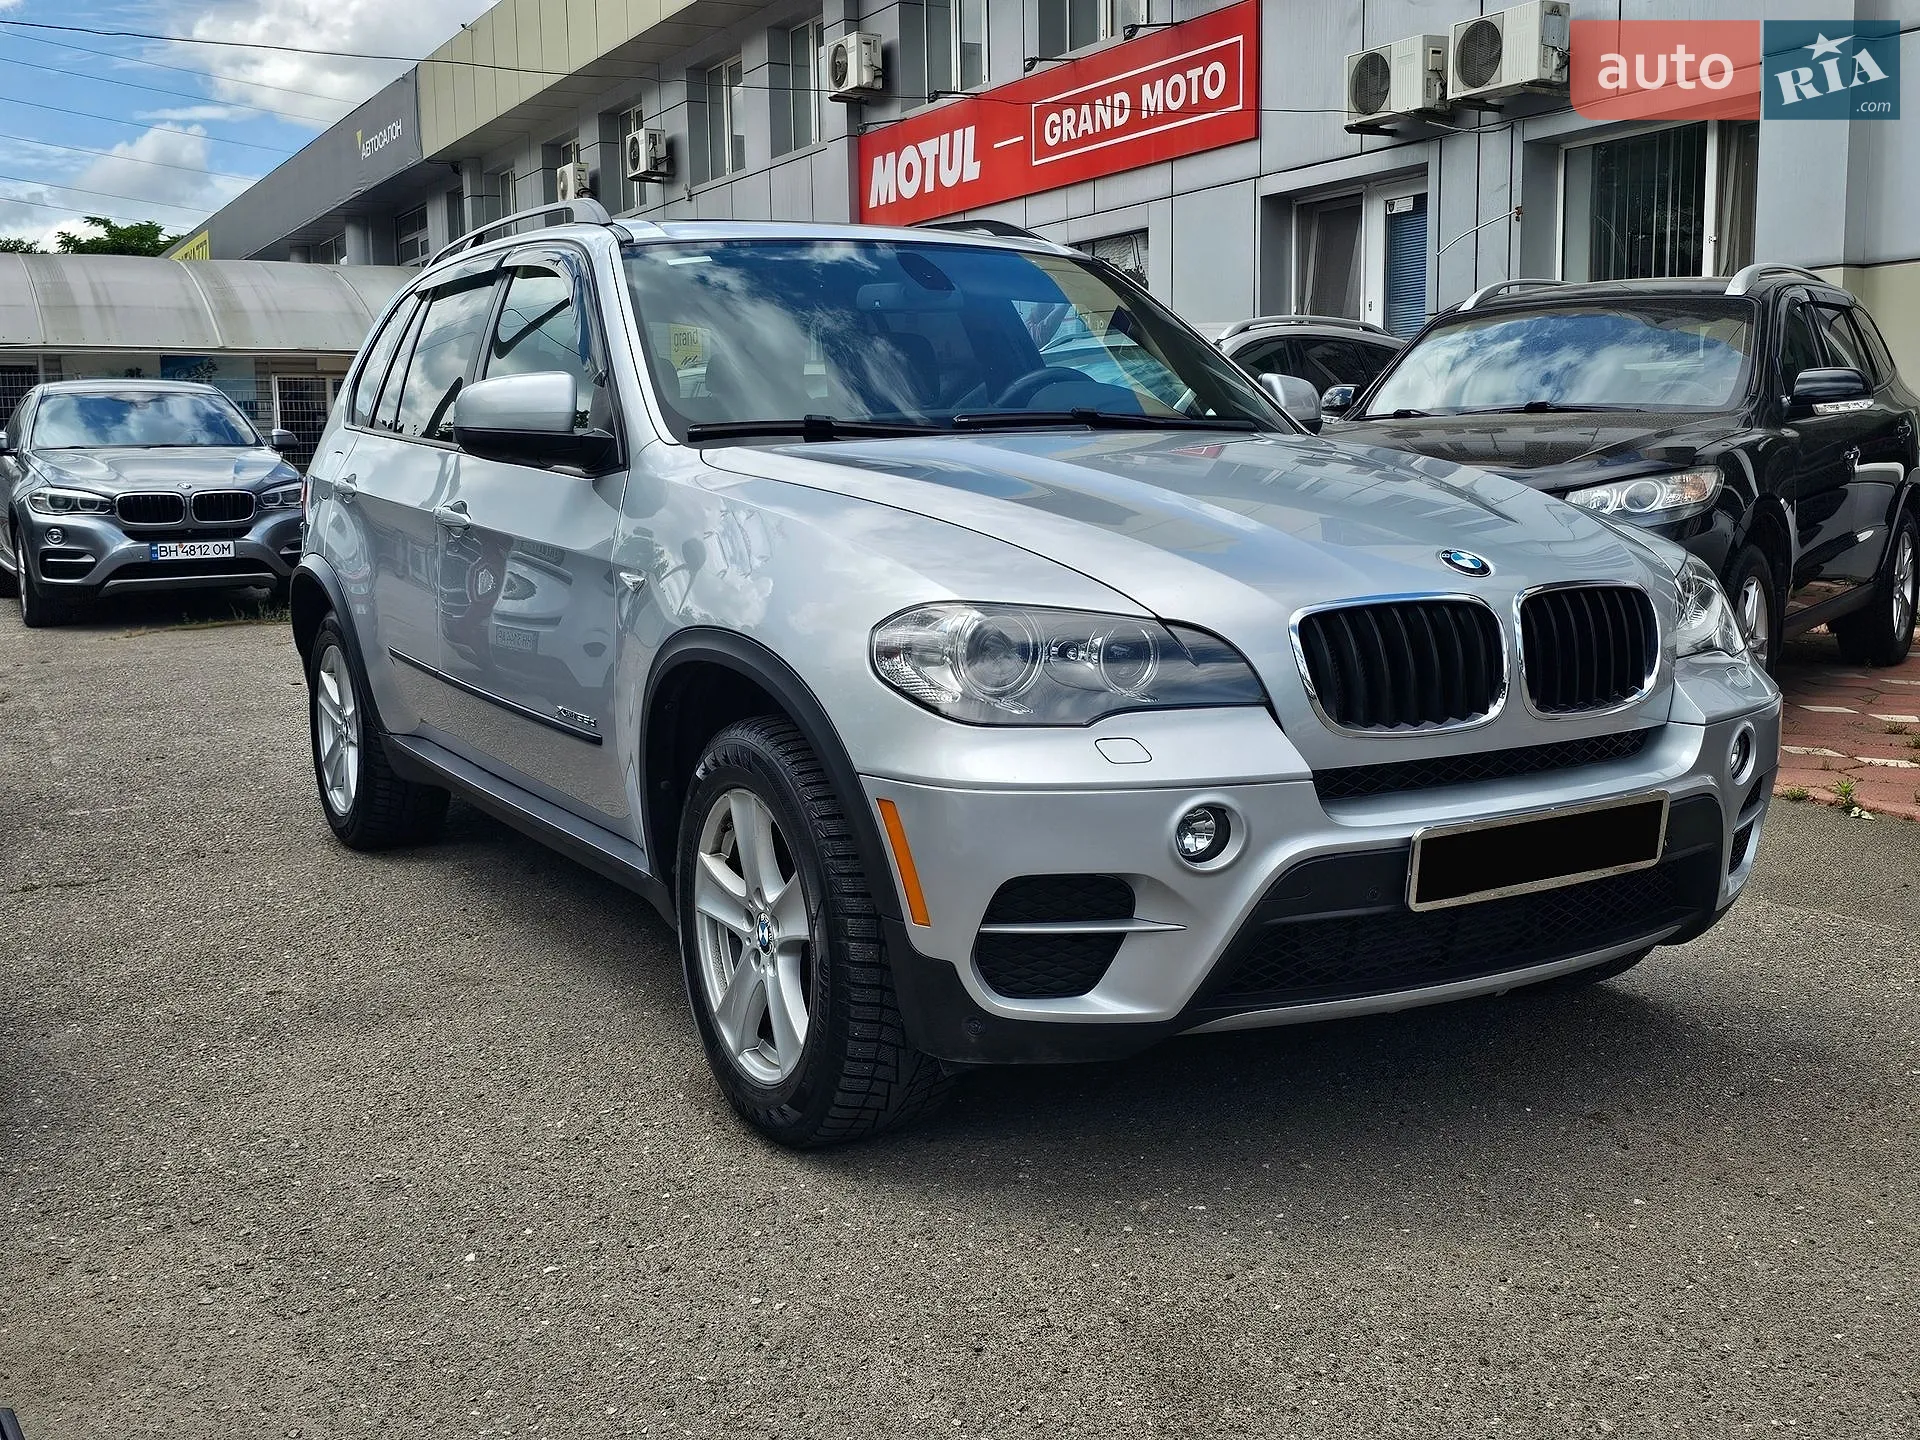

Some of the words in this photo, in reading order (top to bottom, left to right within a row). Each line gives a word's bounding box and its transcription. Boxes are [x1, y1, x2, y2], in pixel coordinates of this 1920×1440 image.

[361, 119, 402, 160] АВТОСАЛОН
[868, 126, 981, 208] MOTUL
[1044, 91, 1131, 147] GRAND
[1141, 60, 1227, 120] MOTO
[159, 545, 179, 558] BH
[212, 543, 231, 555] OM
